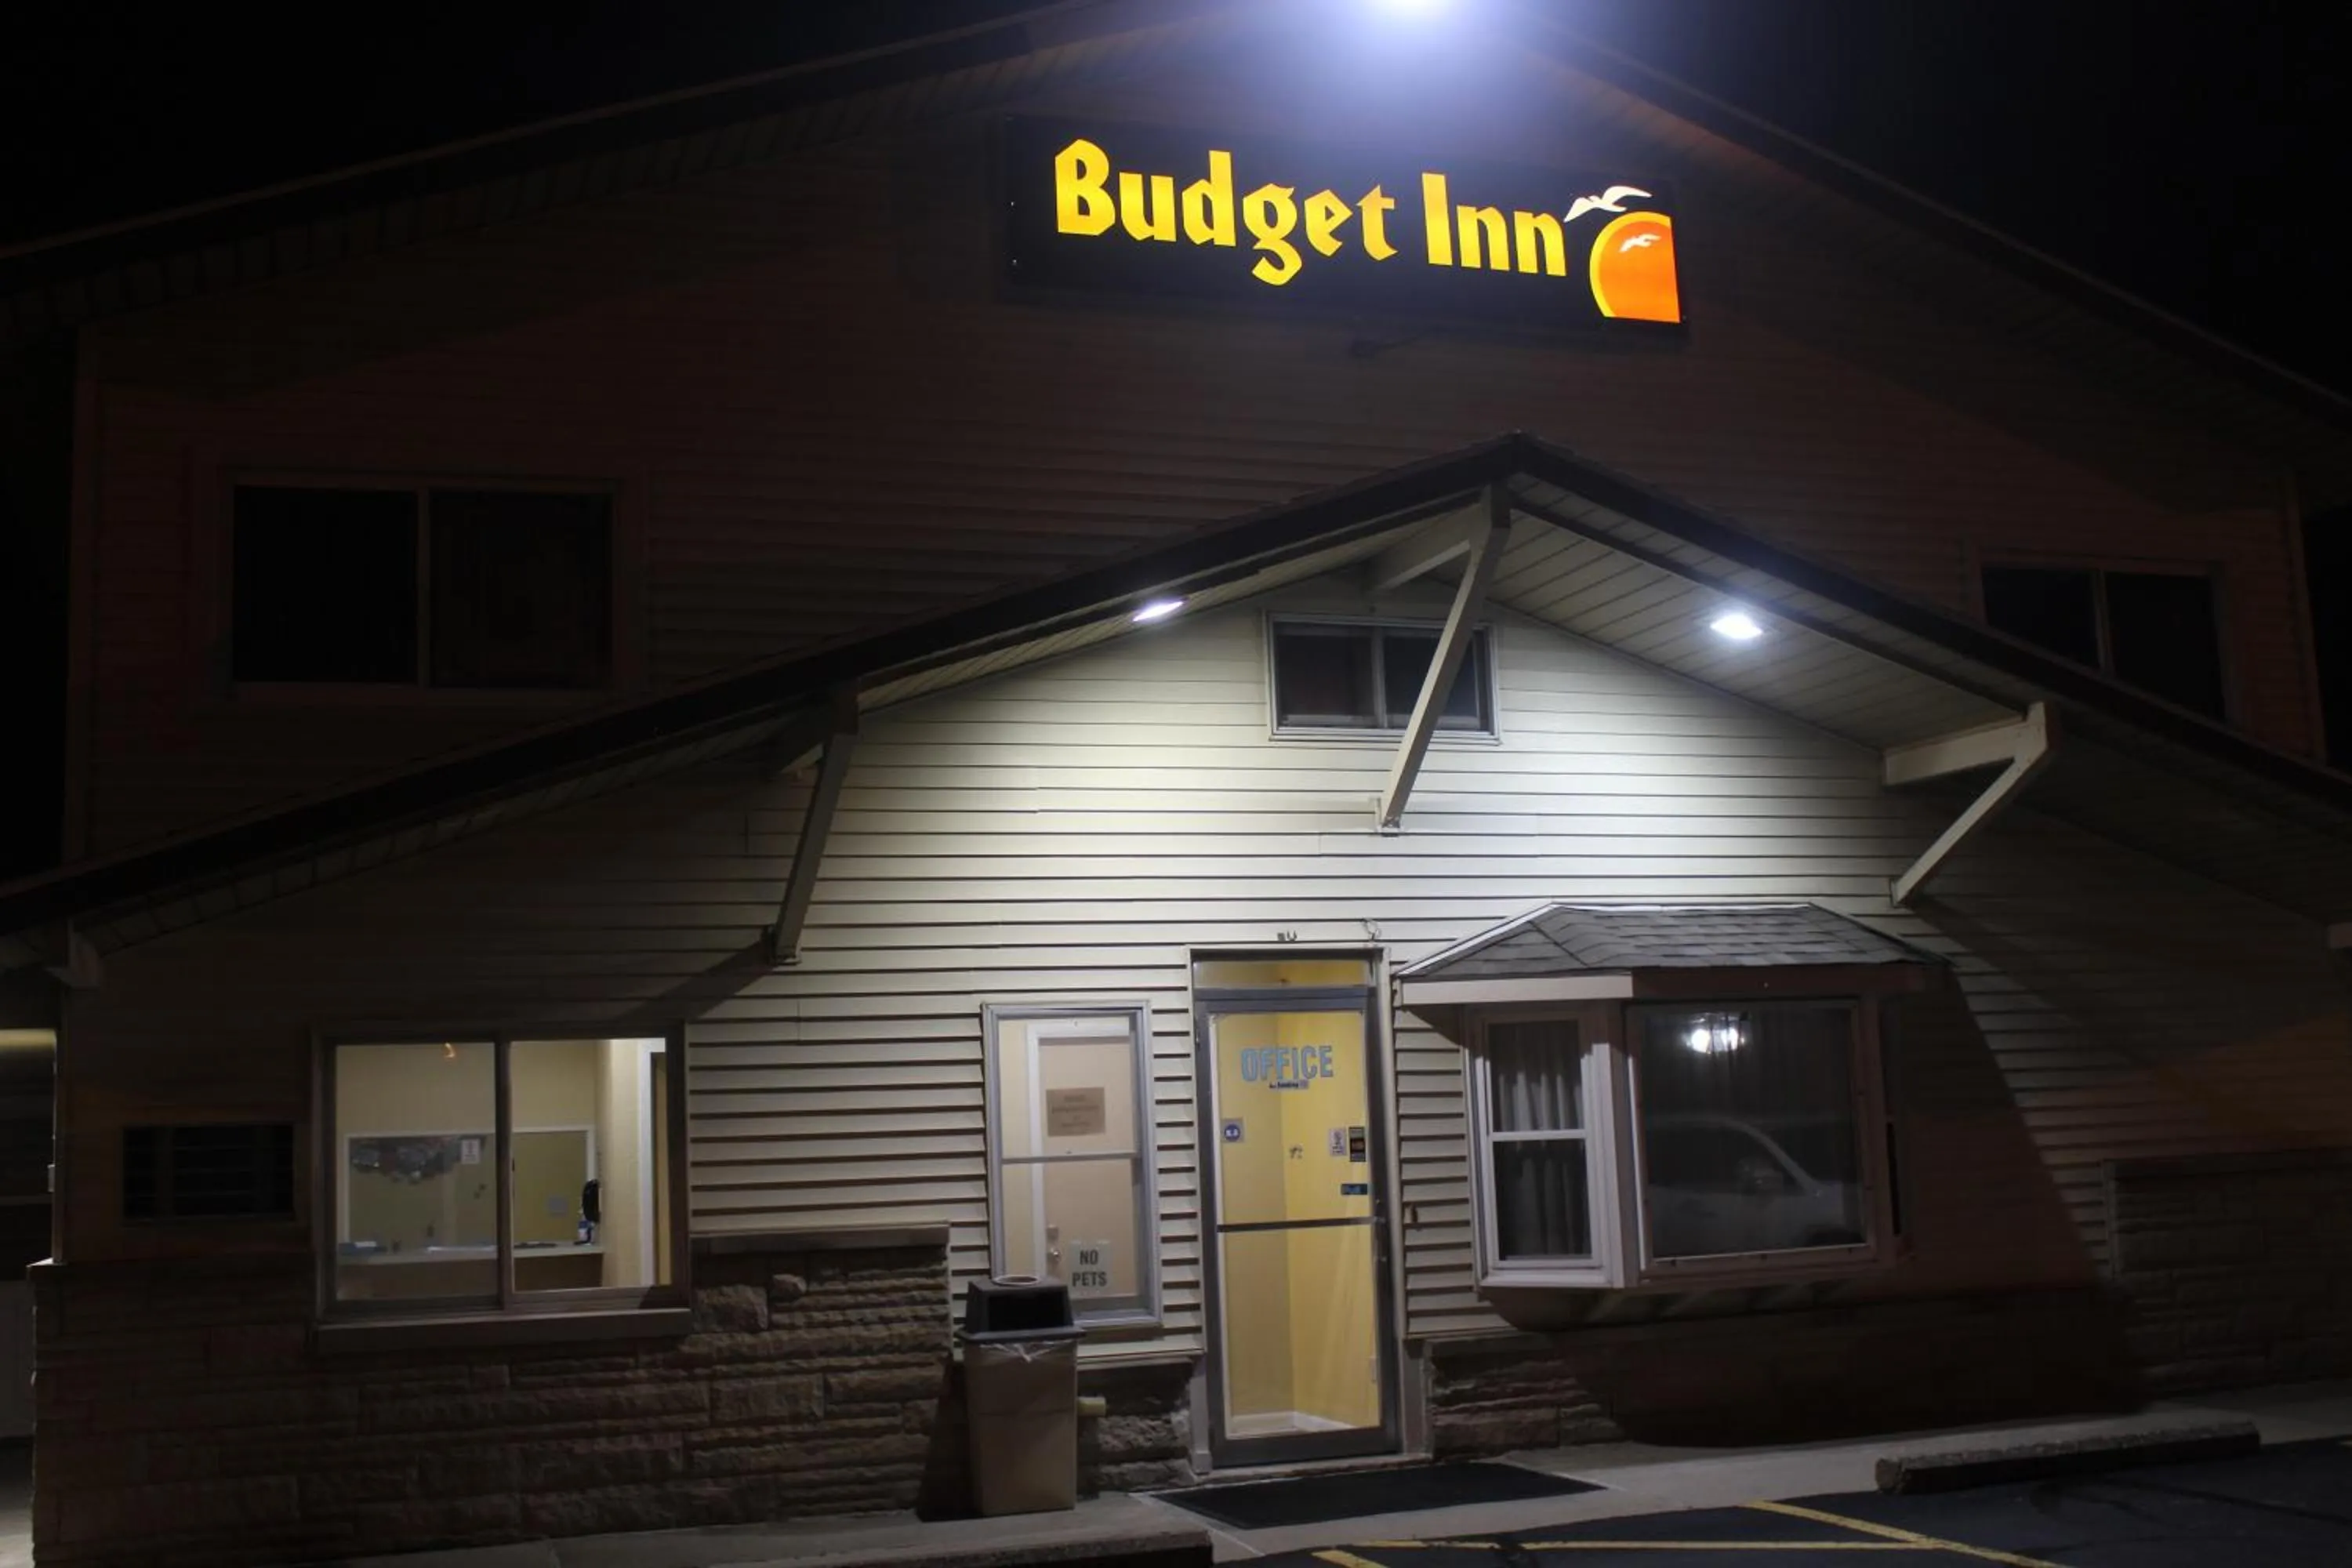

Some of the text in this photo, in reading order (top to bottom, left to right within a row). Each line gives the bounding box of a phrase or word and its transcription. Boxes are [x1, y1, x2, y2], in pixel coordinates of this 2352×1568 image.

[1054, 139, 1567, 285] Budget Inn
[1240, 1045, 1334, 1081] OFFICE
[1080, 1250, 1098, 1265] NO
[1072, 1271, 1107, 1287] PETS
